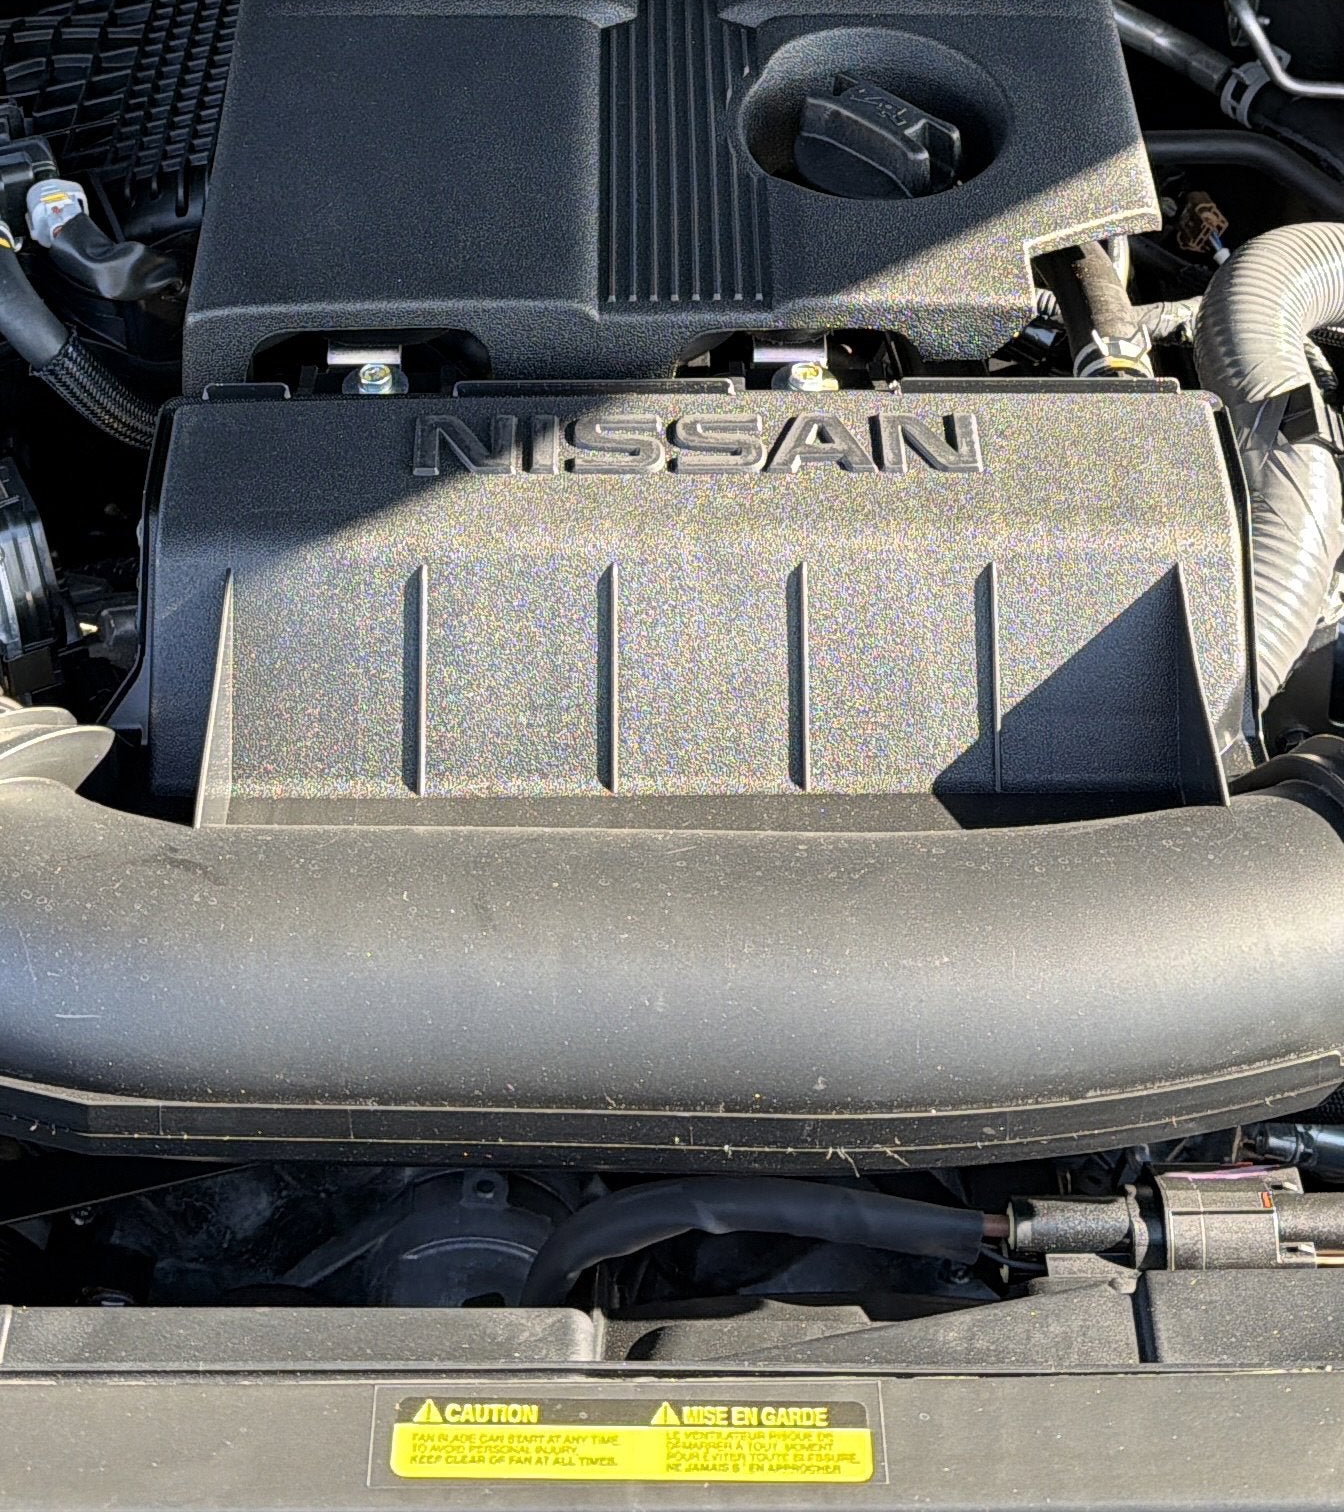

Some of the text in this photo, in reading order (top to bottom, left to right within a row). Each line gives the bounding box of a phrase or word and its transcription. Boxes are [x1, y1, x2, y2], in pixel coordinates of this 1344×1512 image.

[412, 413, 983, 477] NISSAN
[444, 1403, 539, 1423] CAUTION
[681, 1406, 829, 1427] MISE EN GARDE
[412, 1433, 435, 1442] FAN
[479, 1433, 504, 1443] CAN
[507, 1433, 544, 1444] START
[546, 1434, 562, 1444] AT
[563, 1434, 588, 1445] ANY
[412, 1443, 428, 1454] TO
[429, 1444, 466, 1454] AVOID
[468, 1445, 529, 1455] PERSONAL
[409, 1454, 443, 1464] KEEP
[445, 1455, 486, 1465] CLEAR
[488, 1455, 506, 1465] OF
[508, 1455, 533, 1465] FAN
[534, 1456, 550, 1466] AT
[552, 1456, 576, 1466] ALL
